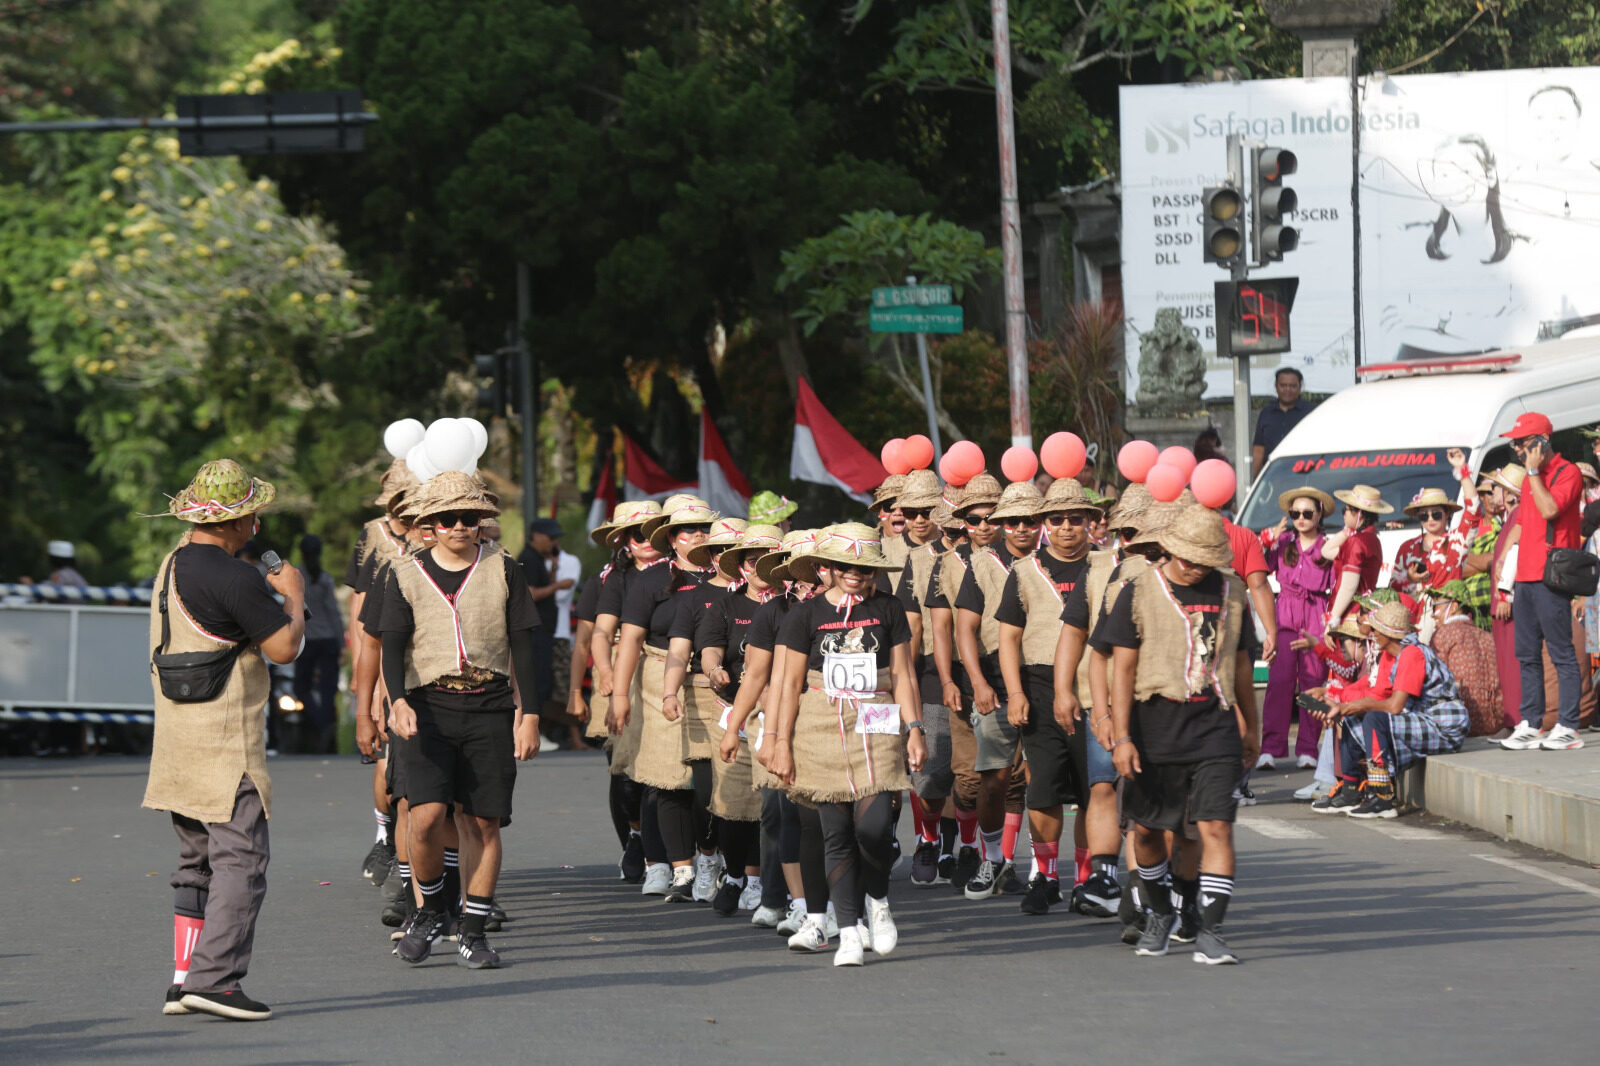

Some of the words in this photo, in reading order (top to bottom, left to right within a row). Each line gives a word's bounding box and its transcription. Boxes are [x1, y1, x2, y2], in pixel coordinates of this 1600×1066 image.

[1193, 111, 1285, 141] Safaga
[1152, 194, 1204, 208] PASSP
[1154, 214, 1180, 227] BST
[1155, 232, 1193, 246] SDSD
[1155, 252, 1181, 265] DLL
[1179, 304, 1214, 319] UISE
[832, 660, 867, 692] 05
